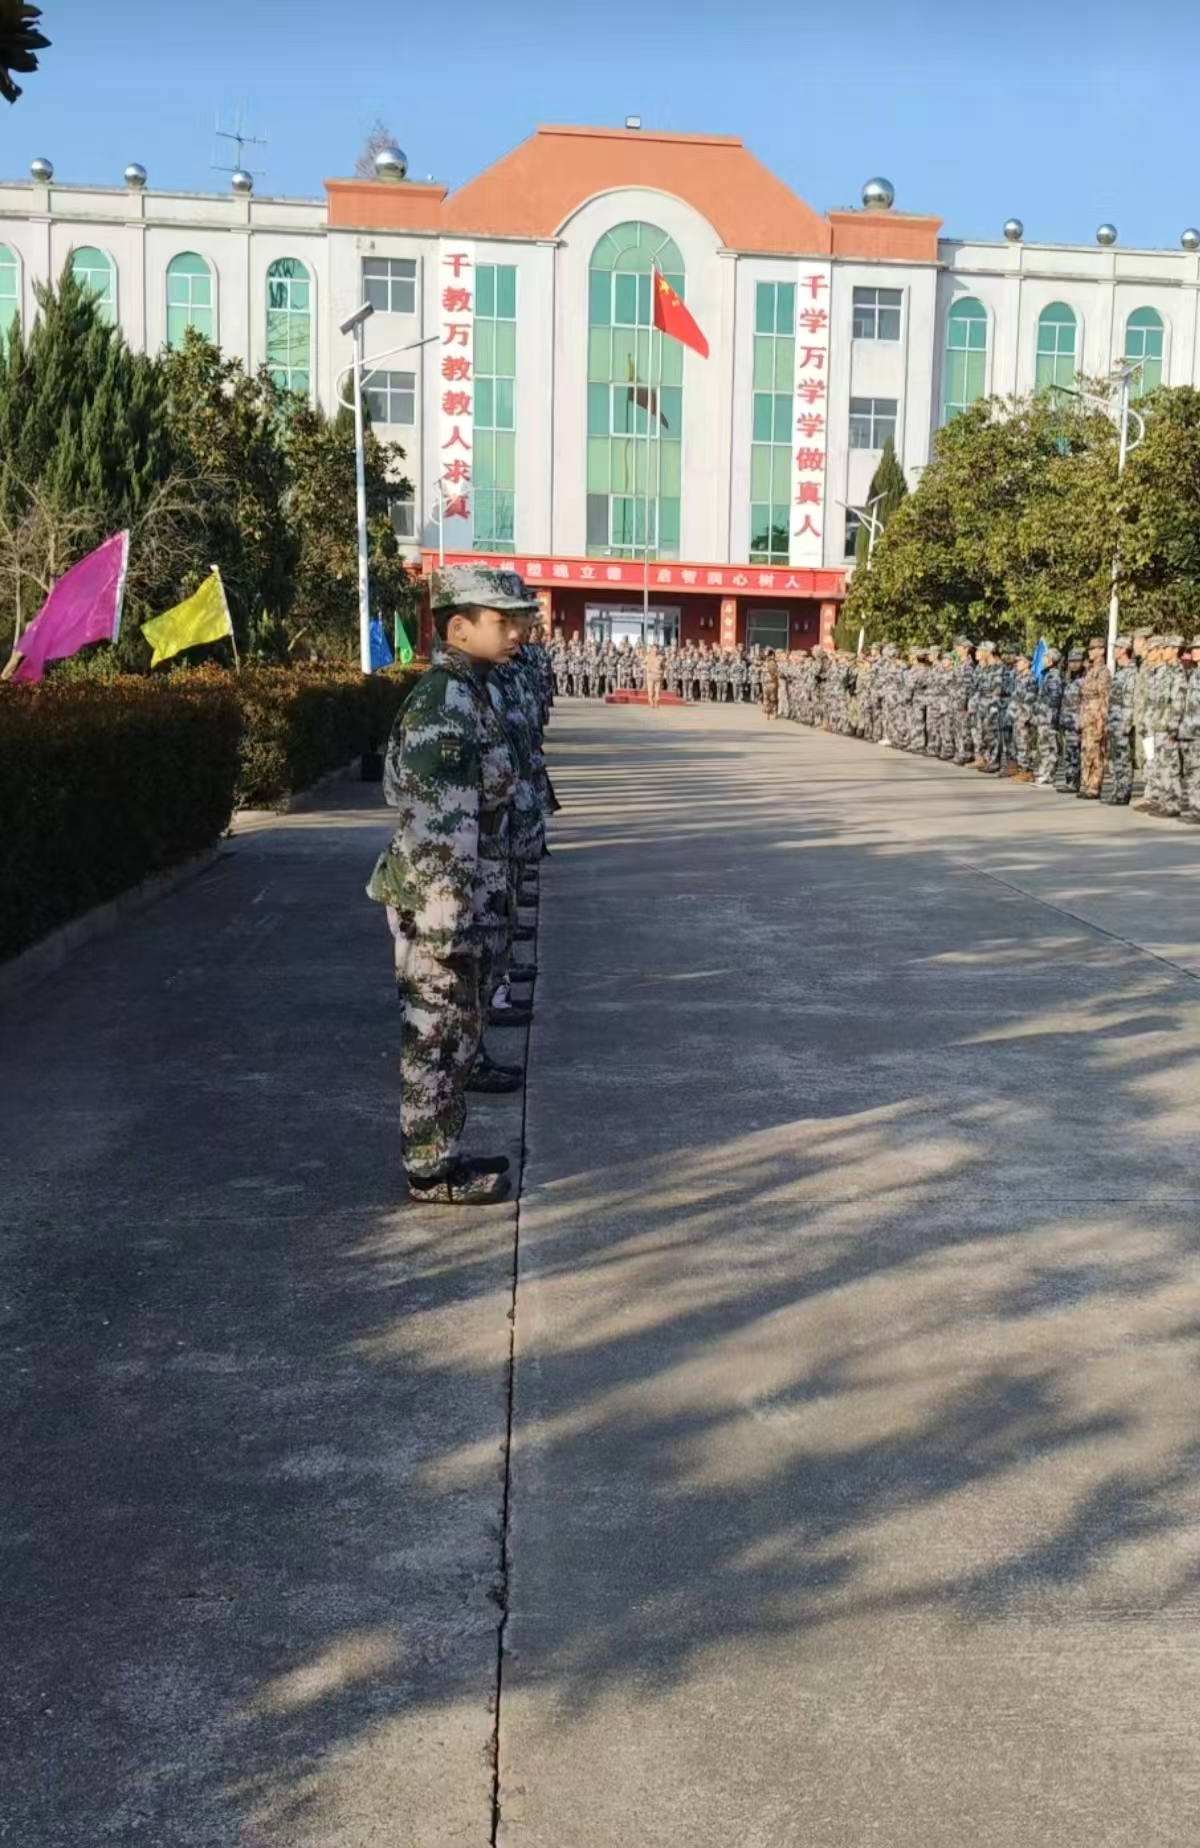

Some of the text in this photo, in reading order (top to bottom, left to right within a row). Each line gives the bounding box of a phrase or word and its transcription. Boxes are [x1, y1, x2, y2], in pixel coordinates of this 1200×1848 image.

[441, 252, 473, 520] 千教万教教人求真
[793, 274, 829, 538] 千学万学学做真人
[656, 568, 800, 589] 启智润心树人
